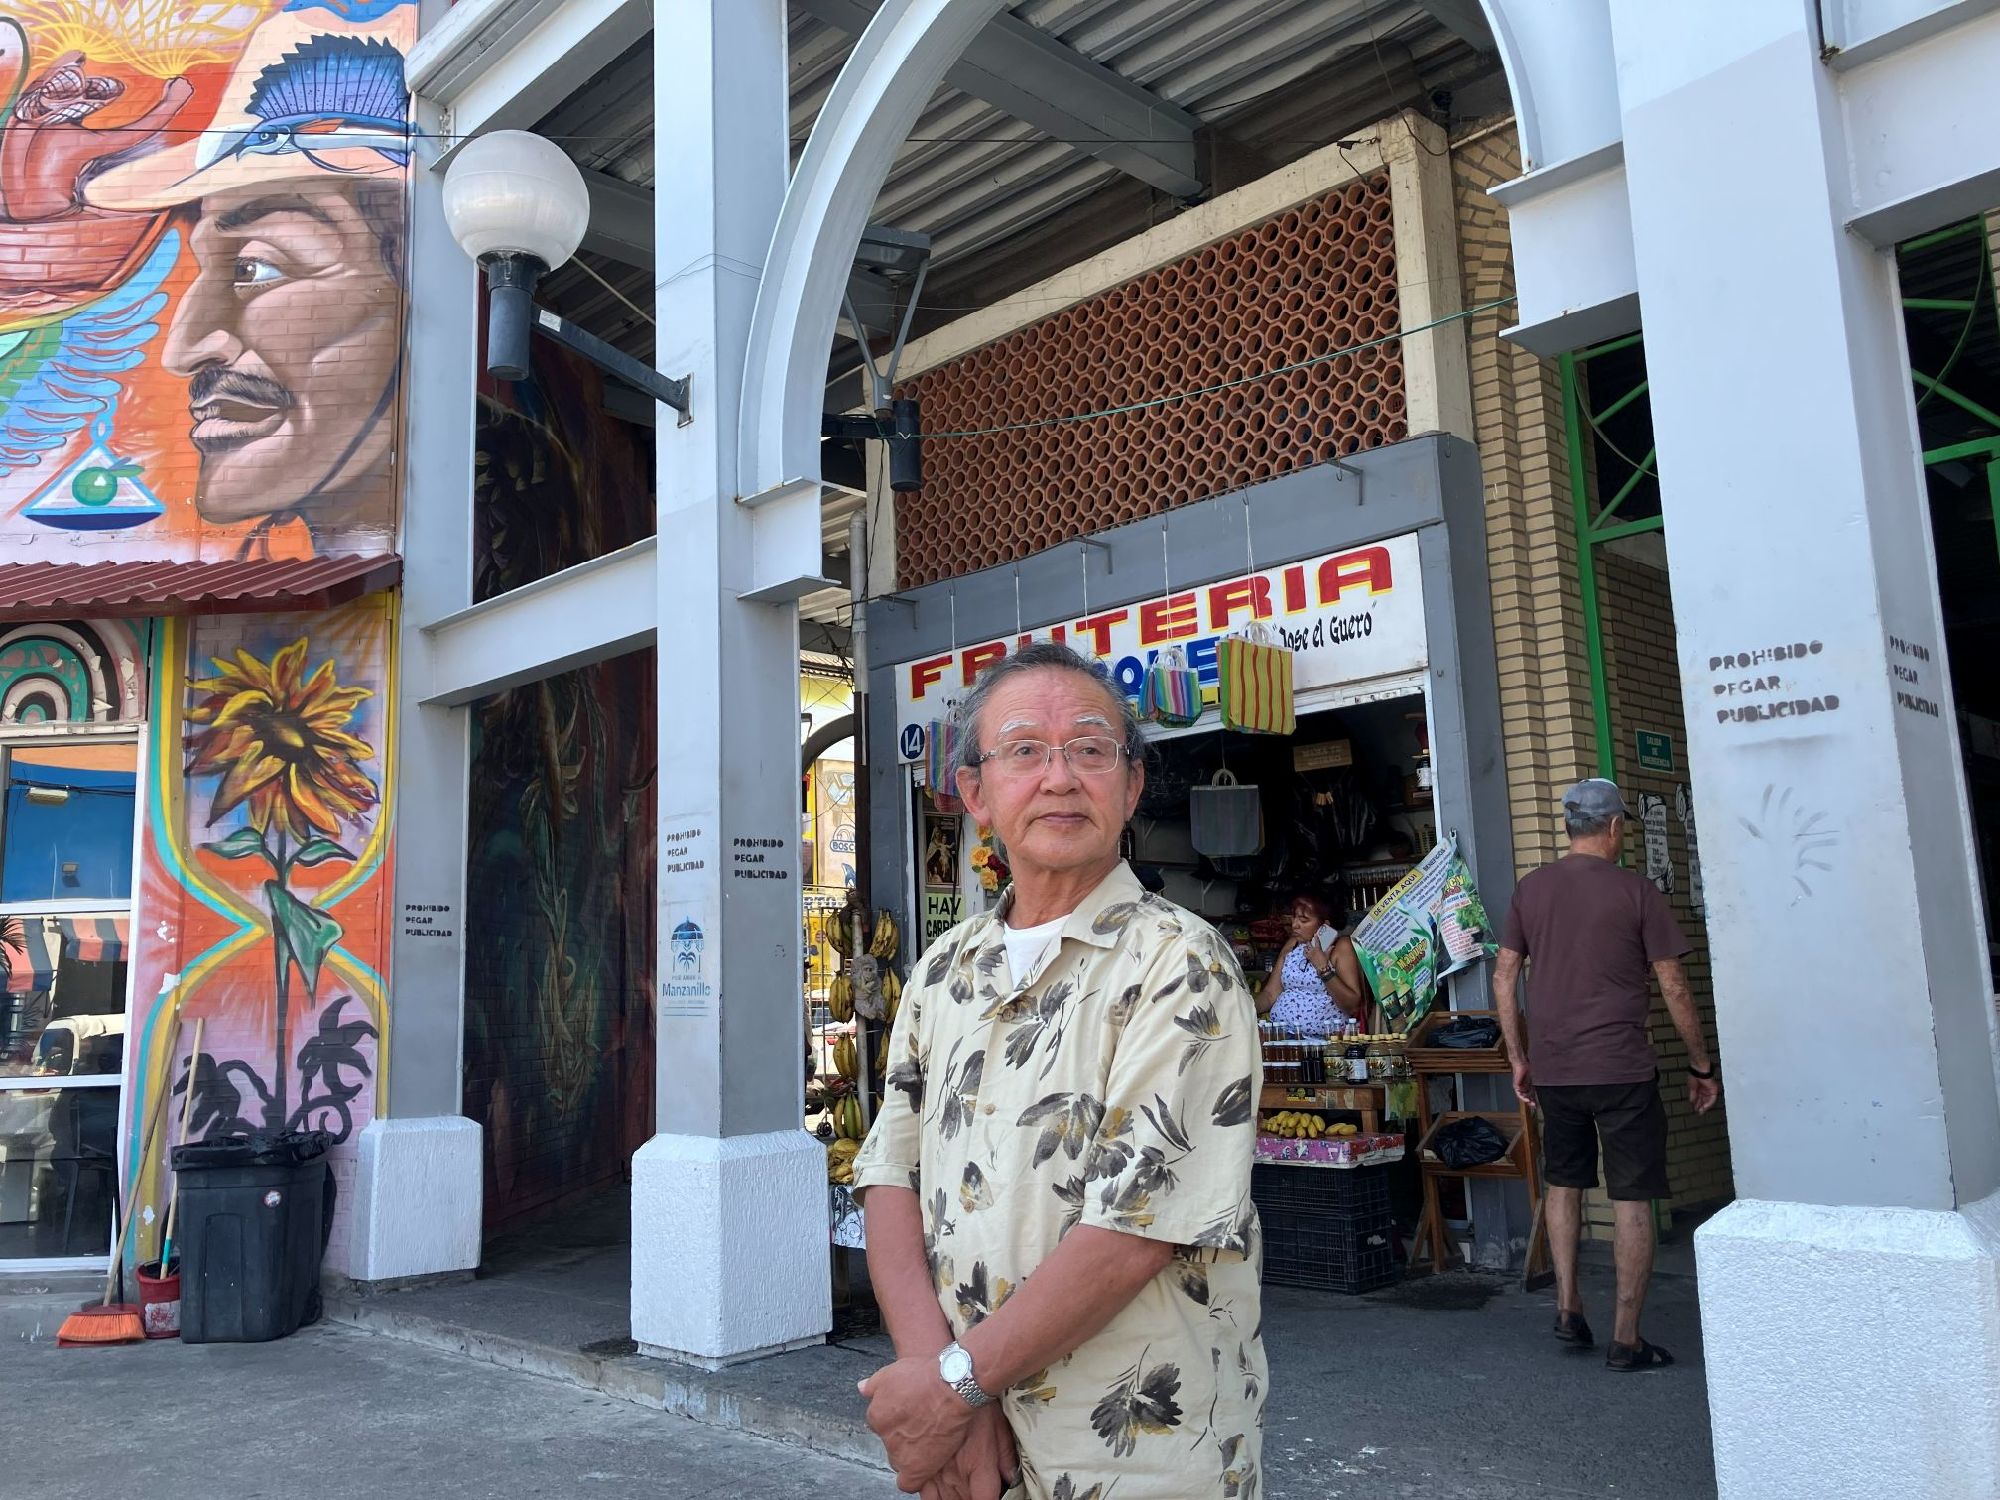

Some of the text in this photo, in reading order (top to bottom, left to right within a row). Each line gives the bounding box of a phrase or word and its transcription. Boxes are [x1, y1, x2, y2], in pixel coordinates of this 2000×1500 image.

[1312, 617, 1325, 647] el
[1709, 639, 1823, 672] PROHIBIDO
[1889, 634, 1930, 663] PROHIBIDO
[1893, 664, 1919, 686] PEGAR
[1713, 675, 1781, 696] PEGAR
[1716, 694, 1840, 724] PUBLICIDAD
[904, 727, 921, 756] 14
[666, 829, 702, 842] PROHIBIDO
[733, 838, 785, 848] PROHIBIDO
[667, 846, 688, 857] PEGAR
[734, 854, 764, 863] PEGAR
[667, 860, 705, 873] PUBLICIDAD
[734, 869, 788, 880] PUBLICIDAD
[928, 896, 961, 916] HAY
[1382, 889, 1401, 908] VENTA
[405, 904, 450, 912] PROHIBIDO
[405, 916, 433, 924] PEGAR
[405, 929, 452, 937] PUBLICIDAD
[662, 982, 711, 997] Manzanillo
